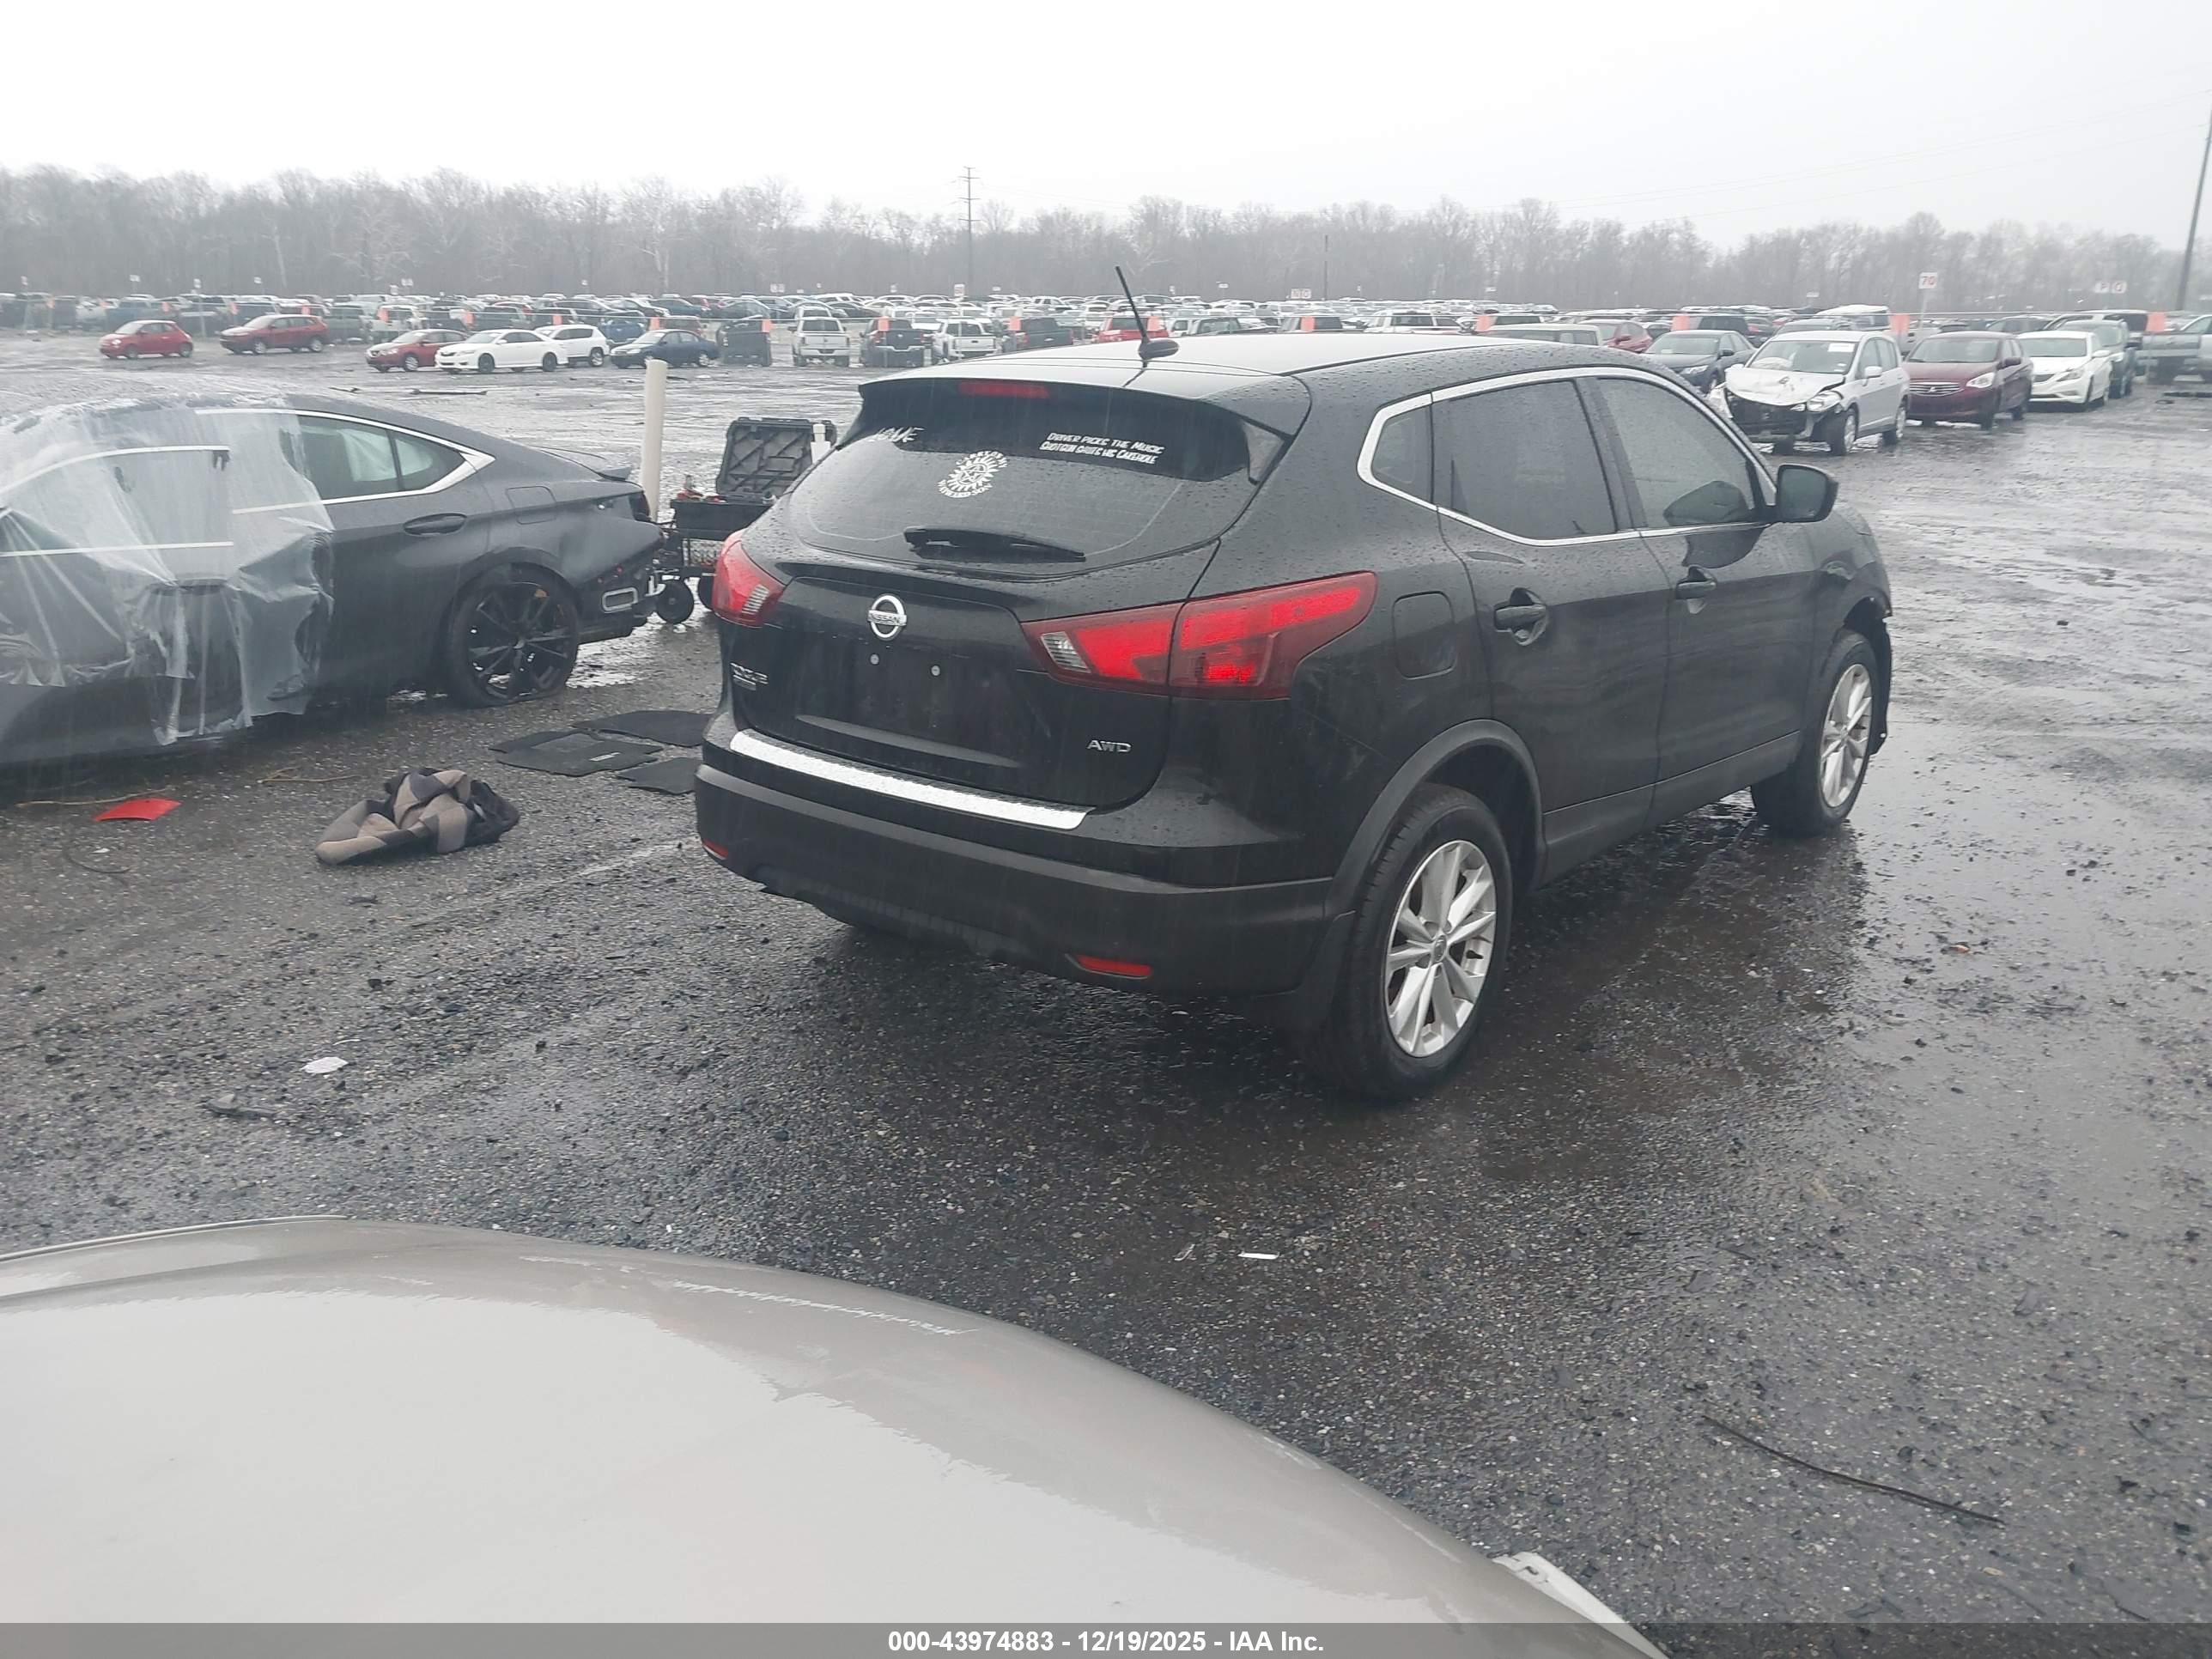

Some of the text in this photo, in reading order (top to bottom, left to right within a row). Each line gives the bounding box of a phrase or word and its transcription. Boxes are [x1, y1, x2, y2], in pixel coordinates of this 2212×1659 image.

[1047, 433, 1082, 443] DRIVER
[1111, 439, 1132, 448] THE
[1131, 441, 1165, 454] MUSIC
[1086, 739, 1132, 752] AWD
